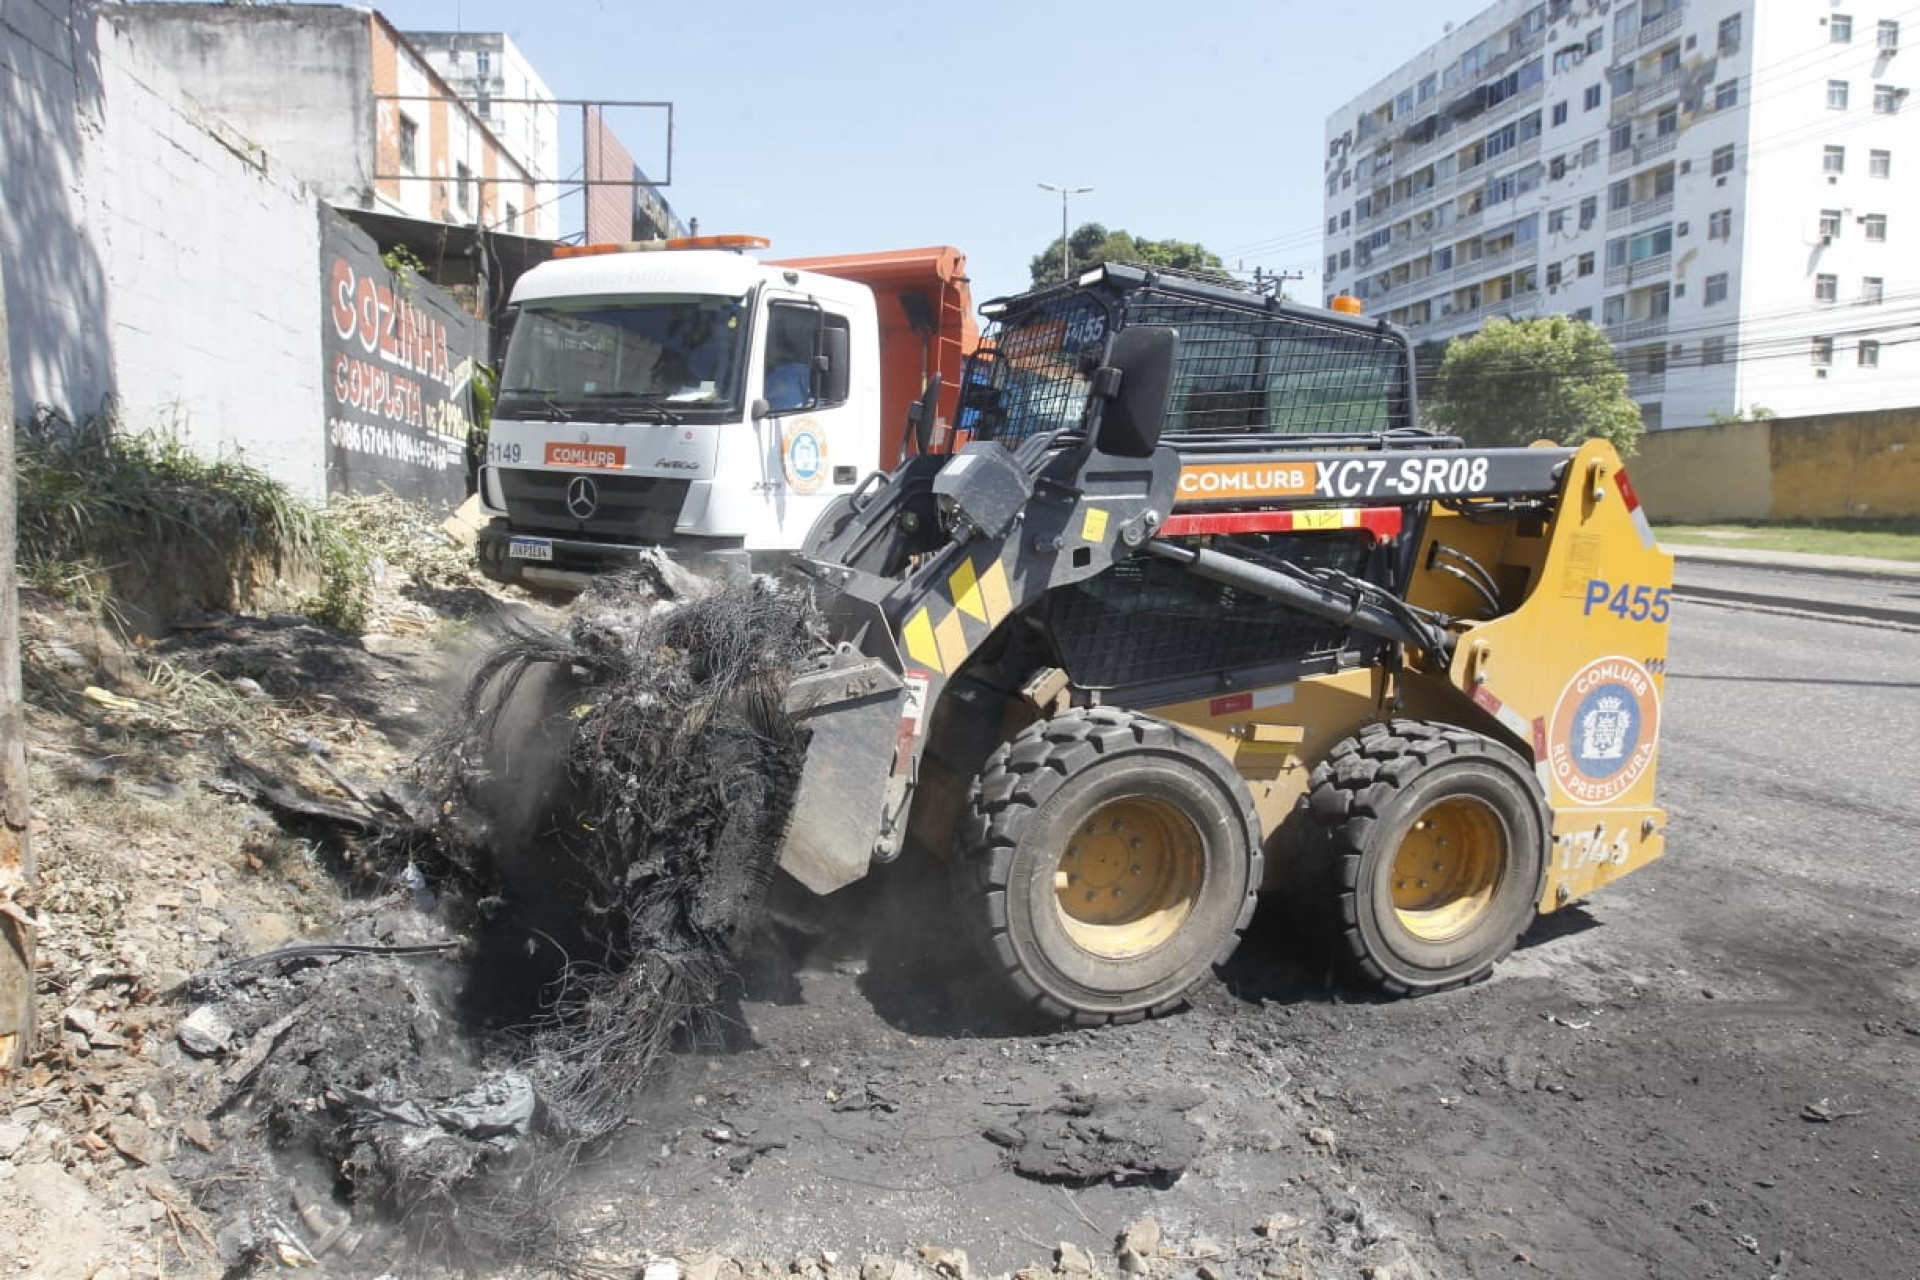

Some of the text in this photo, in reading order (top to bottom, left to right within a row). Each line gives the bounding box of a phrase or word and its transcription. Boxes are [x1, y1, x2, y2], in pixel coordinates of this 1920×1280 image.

[332, 257, 452, 387] COZINHA
[333, 351, 422, 427] COMPLETA
[553, 448, 616, 465] COMLURB
[1315, 457, 1489, 498] XC7-SR08
[1179, 468, 1305, 493] COMLURB
[1583, 579, 1672, 624] P455
[1577, 664, 1648, 696] COMLURB
[1553, 743, 1652, 799] RIO PREFEITURA
